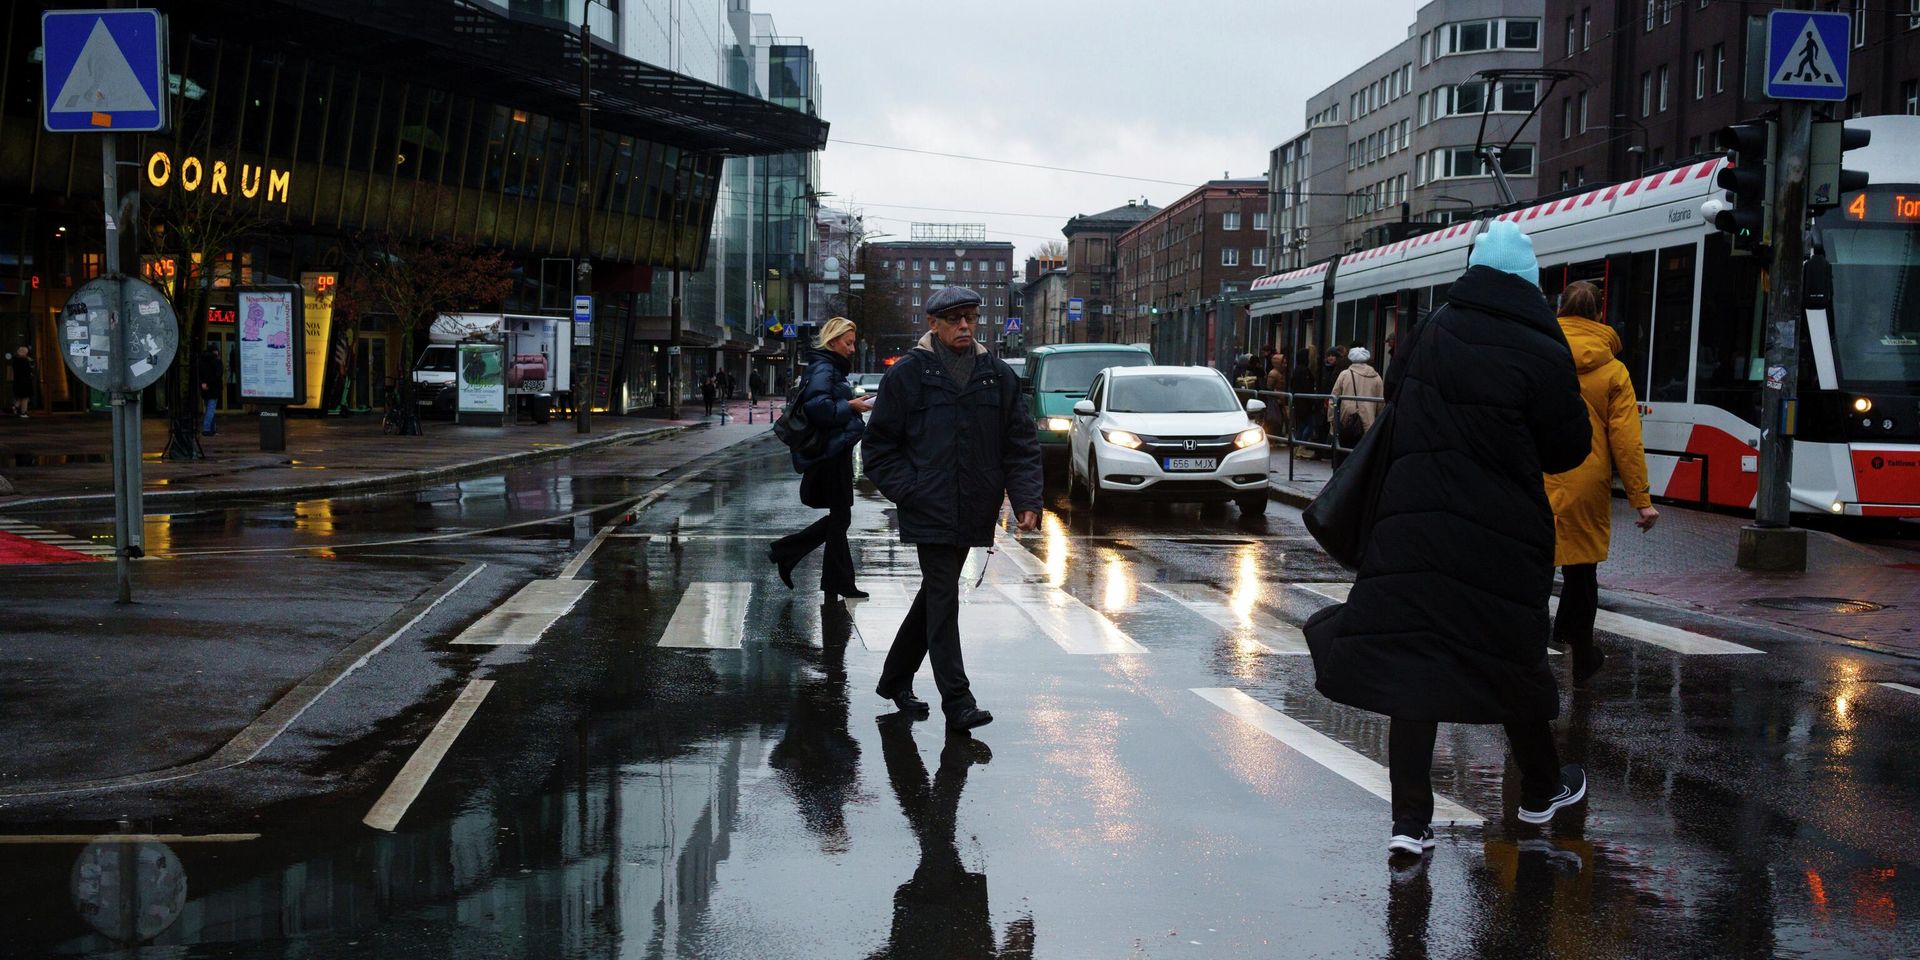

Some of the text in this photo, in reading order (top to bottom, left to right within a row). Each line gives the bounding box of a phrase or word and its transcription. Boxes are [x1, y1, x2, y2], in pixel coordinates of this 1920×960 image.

[1849, 193, 1865, 220] 4
[1173, 459, 1189, 468] 656
[1195, 459, 1214, 468] MJX
